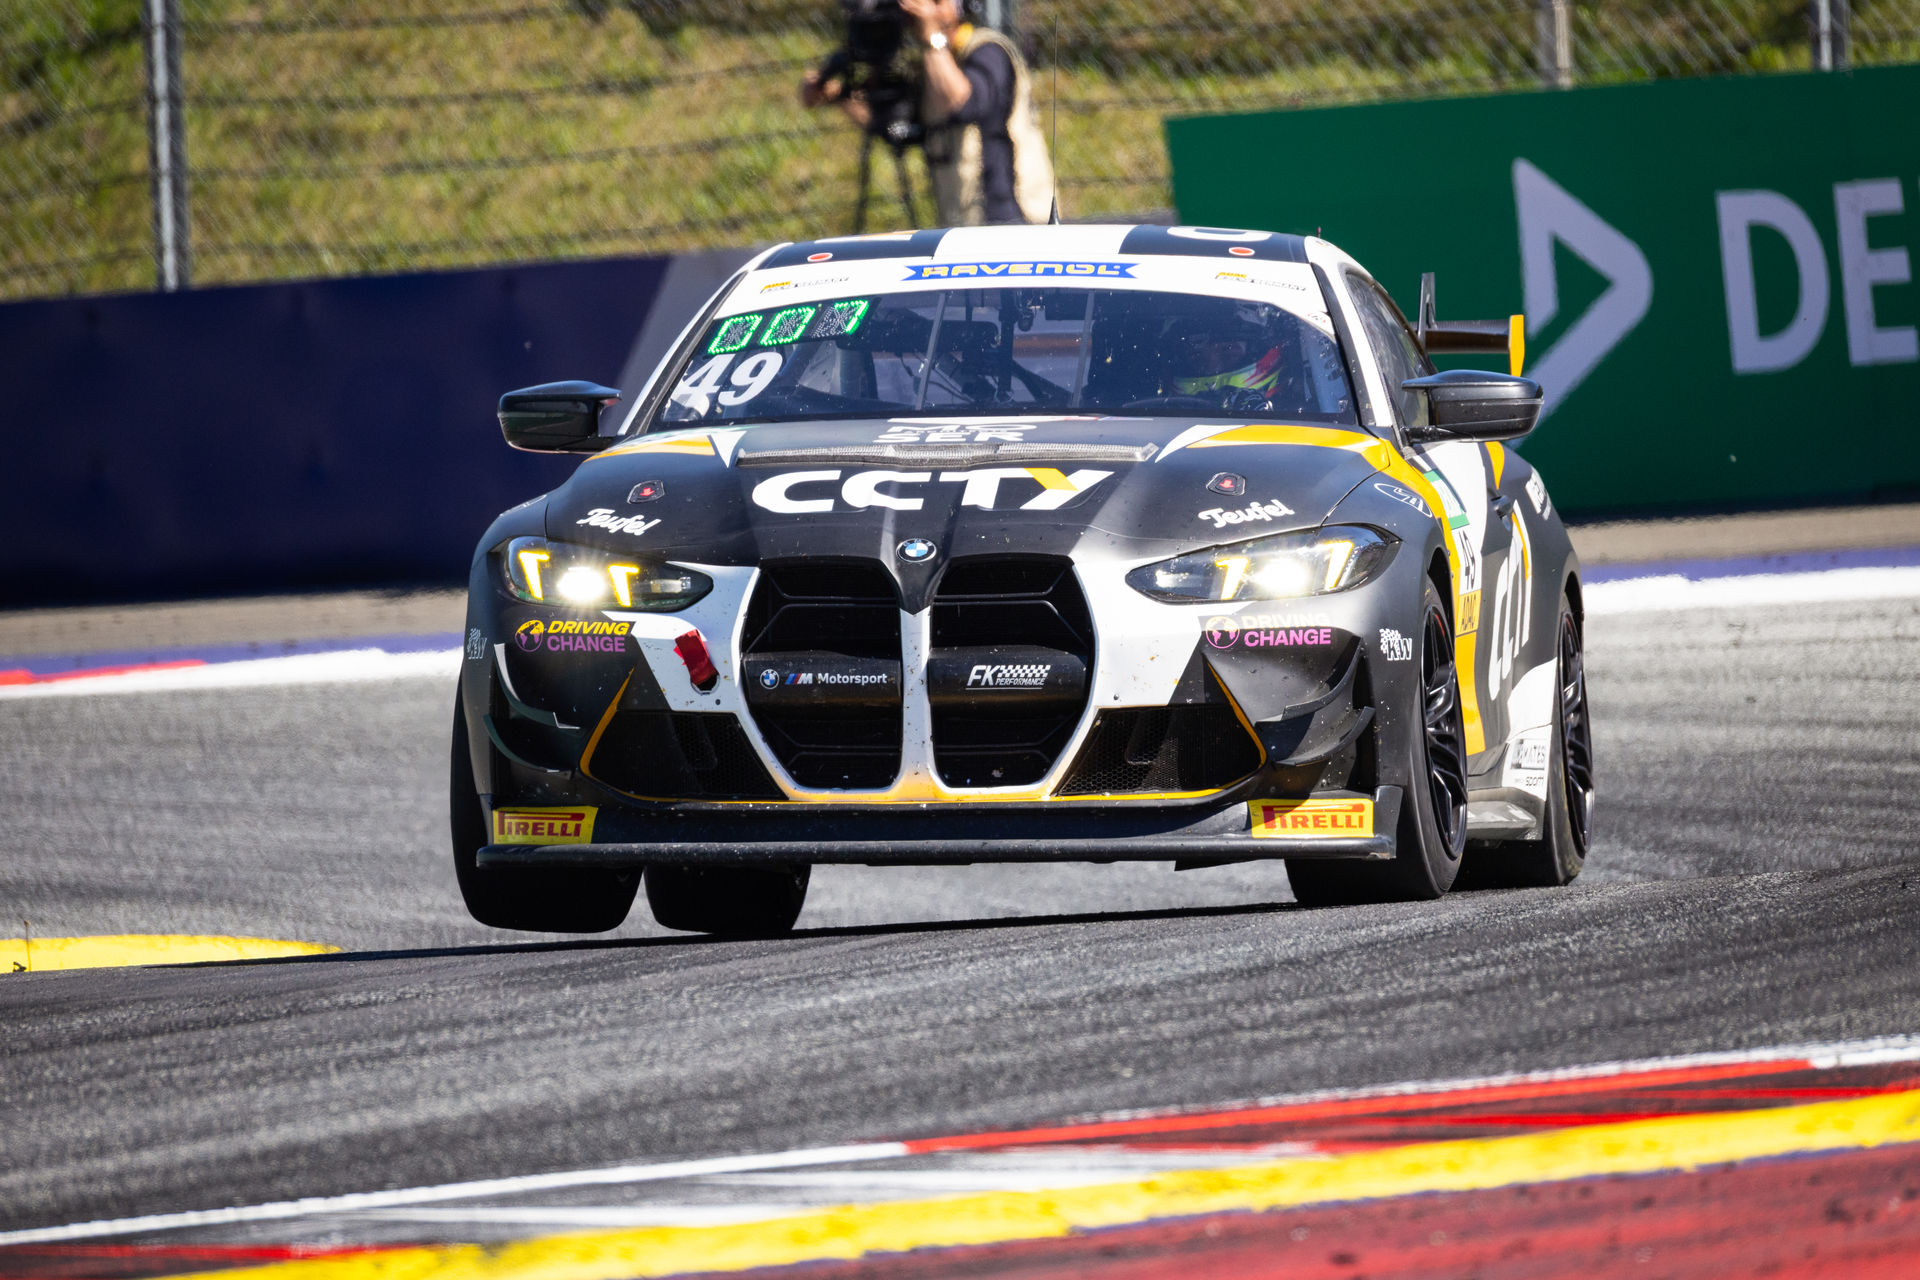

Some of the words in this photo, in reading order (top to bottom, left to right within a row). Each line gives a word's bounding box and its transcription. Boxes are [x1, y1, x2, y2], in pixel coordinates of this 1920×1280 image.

[922, 263, 1120, 277] RAVENOL
[1715, 176, 1920, 376] DE
[678, 351, 783, 414] 49
[752, 468, 1116, 514] CCTY
[576, 508, 662, 536] Teufel
[1198, 499, 1296, 528] Teufel
[547, 620, 630, 636] DRIVING
[1241, 613, 1330, 630] DRIVING
[547, 636, 626, 653] CHANGE
[1244, 629, 1332, 647] CHANGE
[817, 672, 888, 686] Motorsport
[966, 665, 1001, 687] FK
[995, 677, 1046, 686] PERFORMANCE
[498, 811, 586, 837] PIRELLI
[1262, 803, 1365, 829] PIRELLI
